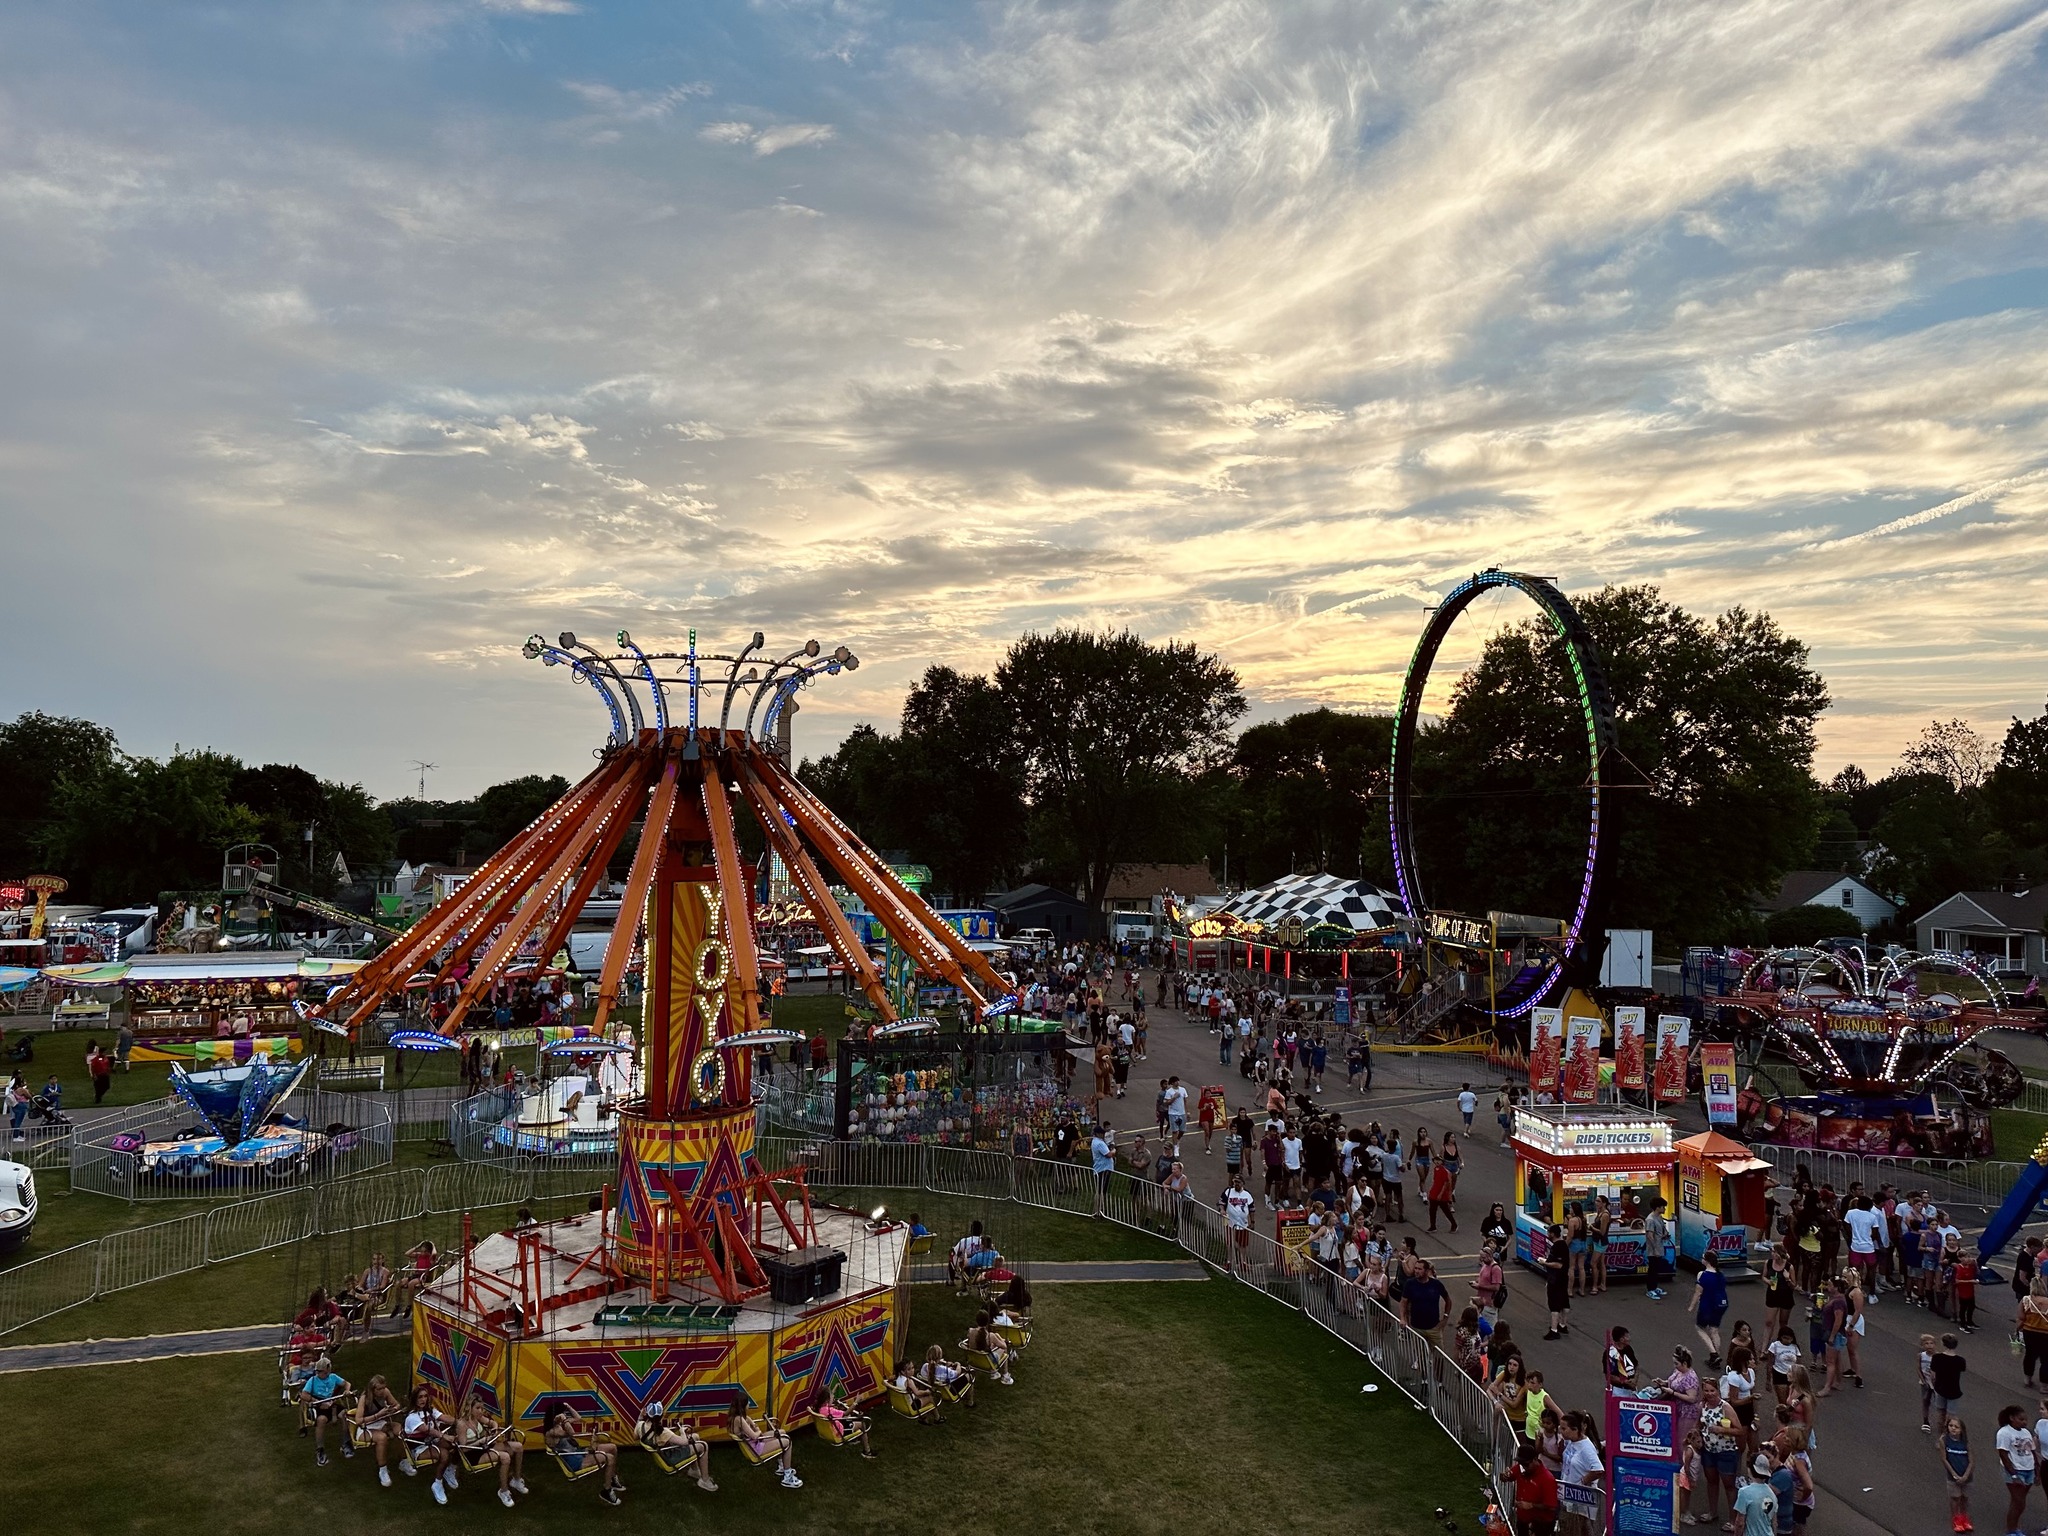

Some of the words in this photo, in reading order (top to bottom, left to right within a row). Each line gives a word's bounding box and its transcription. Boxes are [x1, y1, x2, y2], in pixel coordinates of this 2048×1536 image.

[27, 878, 65, 891] HOUSE
[1431, 914, 1451, 937] RING
[1451, 918, 1463, 939] OF
[1463, 920, 1482, 943] FIRE
[1537, 1014, 1555, 1025] BUY
[1620, 1013, 1638, 1024] BUY
[1574, 1025, 1594, 1035] BUY
[1663, 1023, 1682, 1034] BUY
[1827, 1016, 1887, 1033] TORNADO
[1707, 1057, 1729, 1067] ATM
[1538, 1077, 1556, 1087] HERE
[1623, 1075, 1643, 1085] HERE
[1572, 1089, 1595, 1099] HERE
[1662, 1088, 1683, 1098] HERE
[1710, 1103, 1734, 1113] HERE
[1521, 1123, 1533, 1134] RIDE
[1533, 1127, 1551, 1140] TICKETS
[1576, 1133, 1603, 1145] RIDE
[1605, 1132, 1652, 1145] TICKETS
[1681, 1164, 1701, 1180] ATM
[1707, 1234, 1743, 1251] ATM
[1604, 1254, 1644, 1266] ICKETS
[1637, 1414, 1653, 1434] 4
[1630, 1435, 1662, 1446] TICKETS
[1565, 1486, 1595, 1502] ENTRANC
